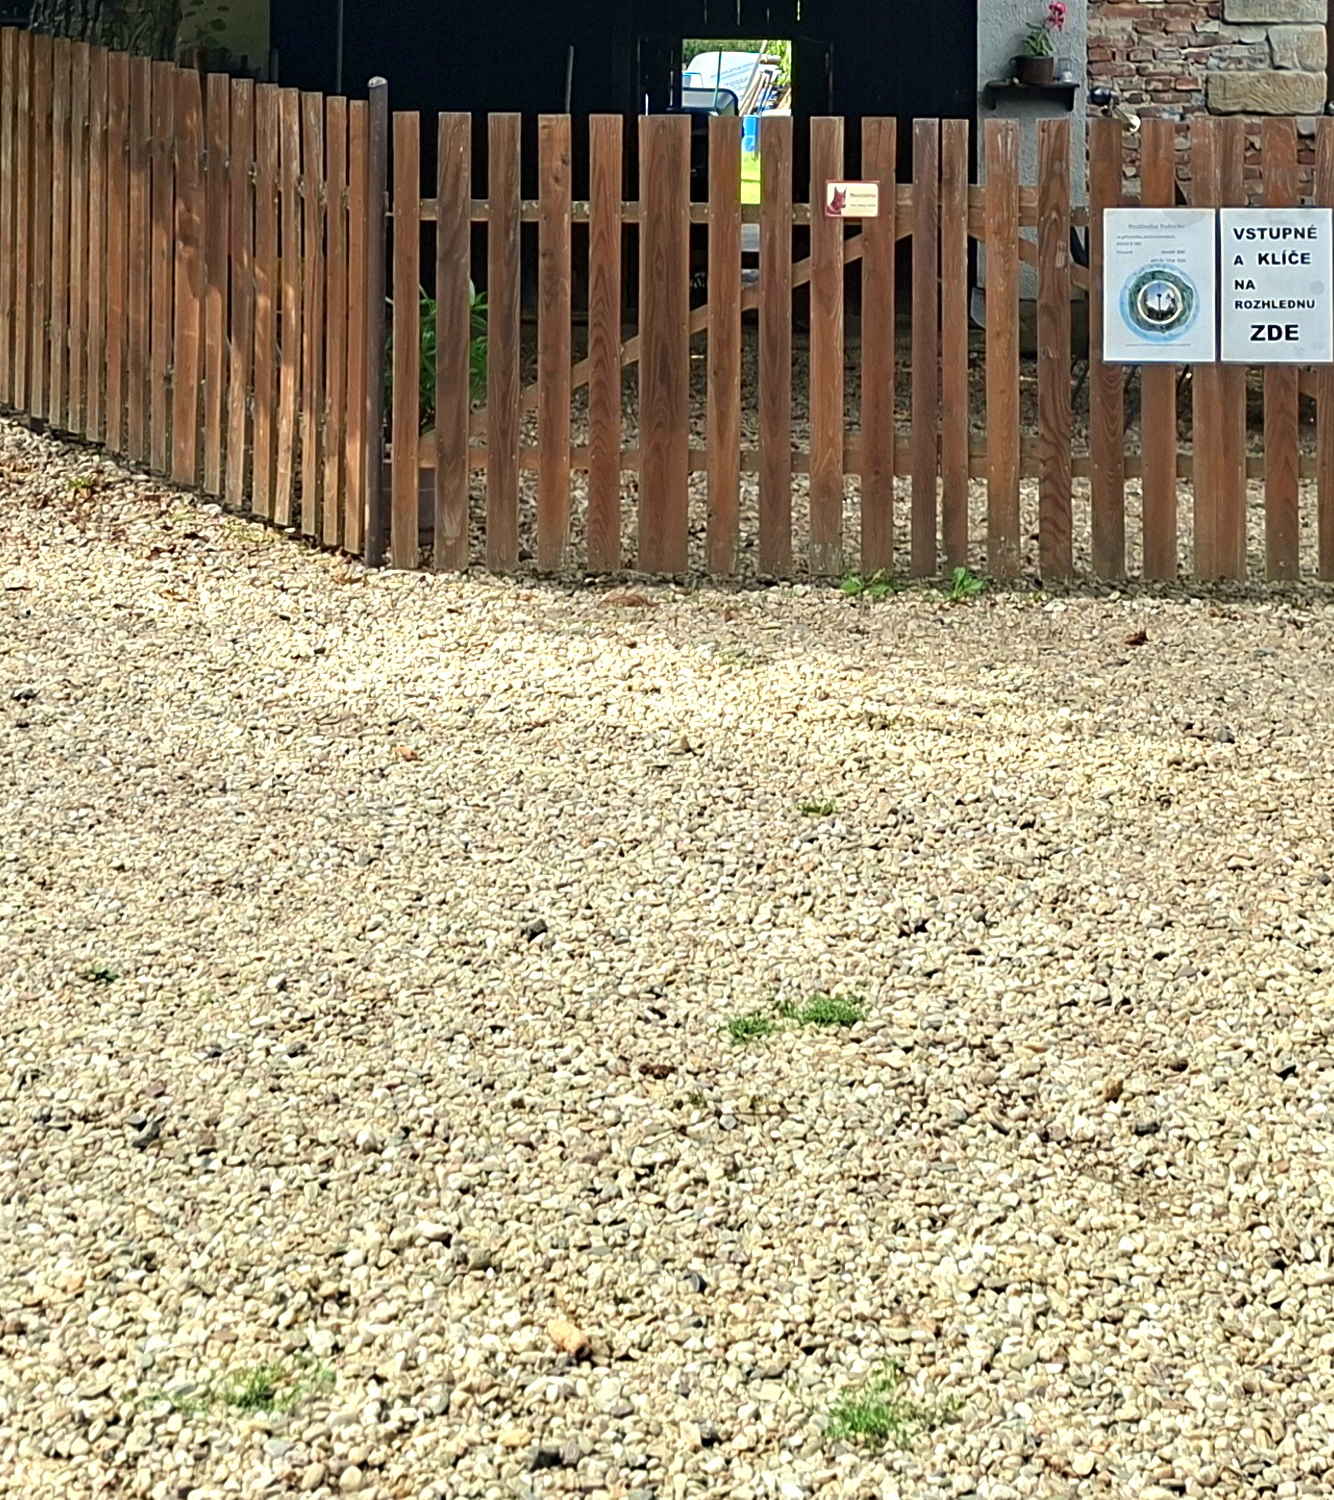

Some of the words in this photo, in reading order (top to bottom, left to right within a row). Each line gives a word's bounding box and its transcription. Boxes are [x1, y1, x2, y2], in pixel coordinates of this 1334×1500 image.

[1233, 224, 1318, 241] VSTUPNÉ
[1233, 255, 1244, 266] A
[1257, 249, 1312, 266] KLÍČE
[1234, 279, 1256, 291] NA
[1234, 299, 1316, 310] ROZHLEDNU
[1250, 324, 1300, 342] ZDE
